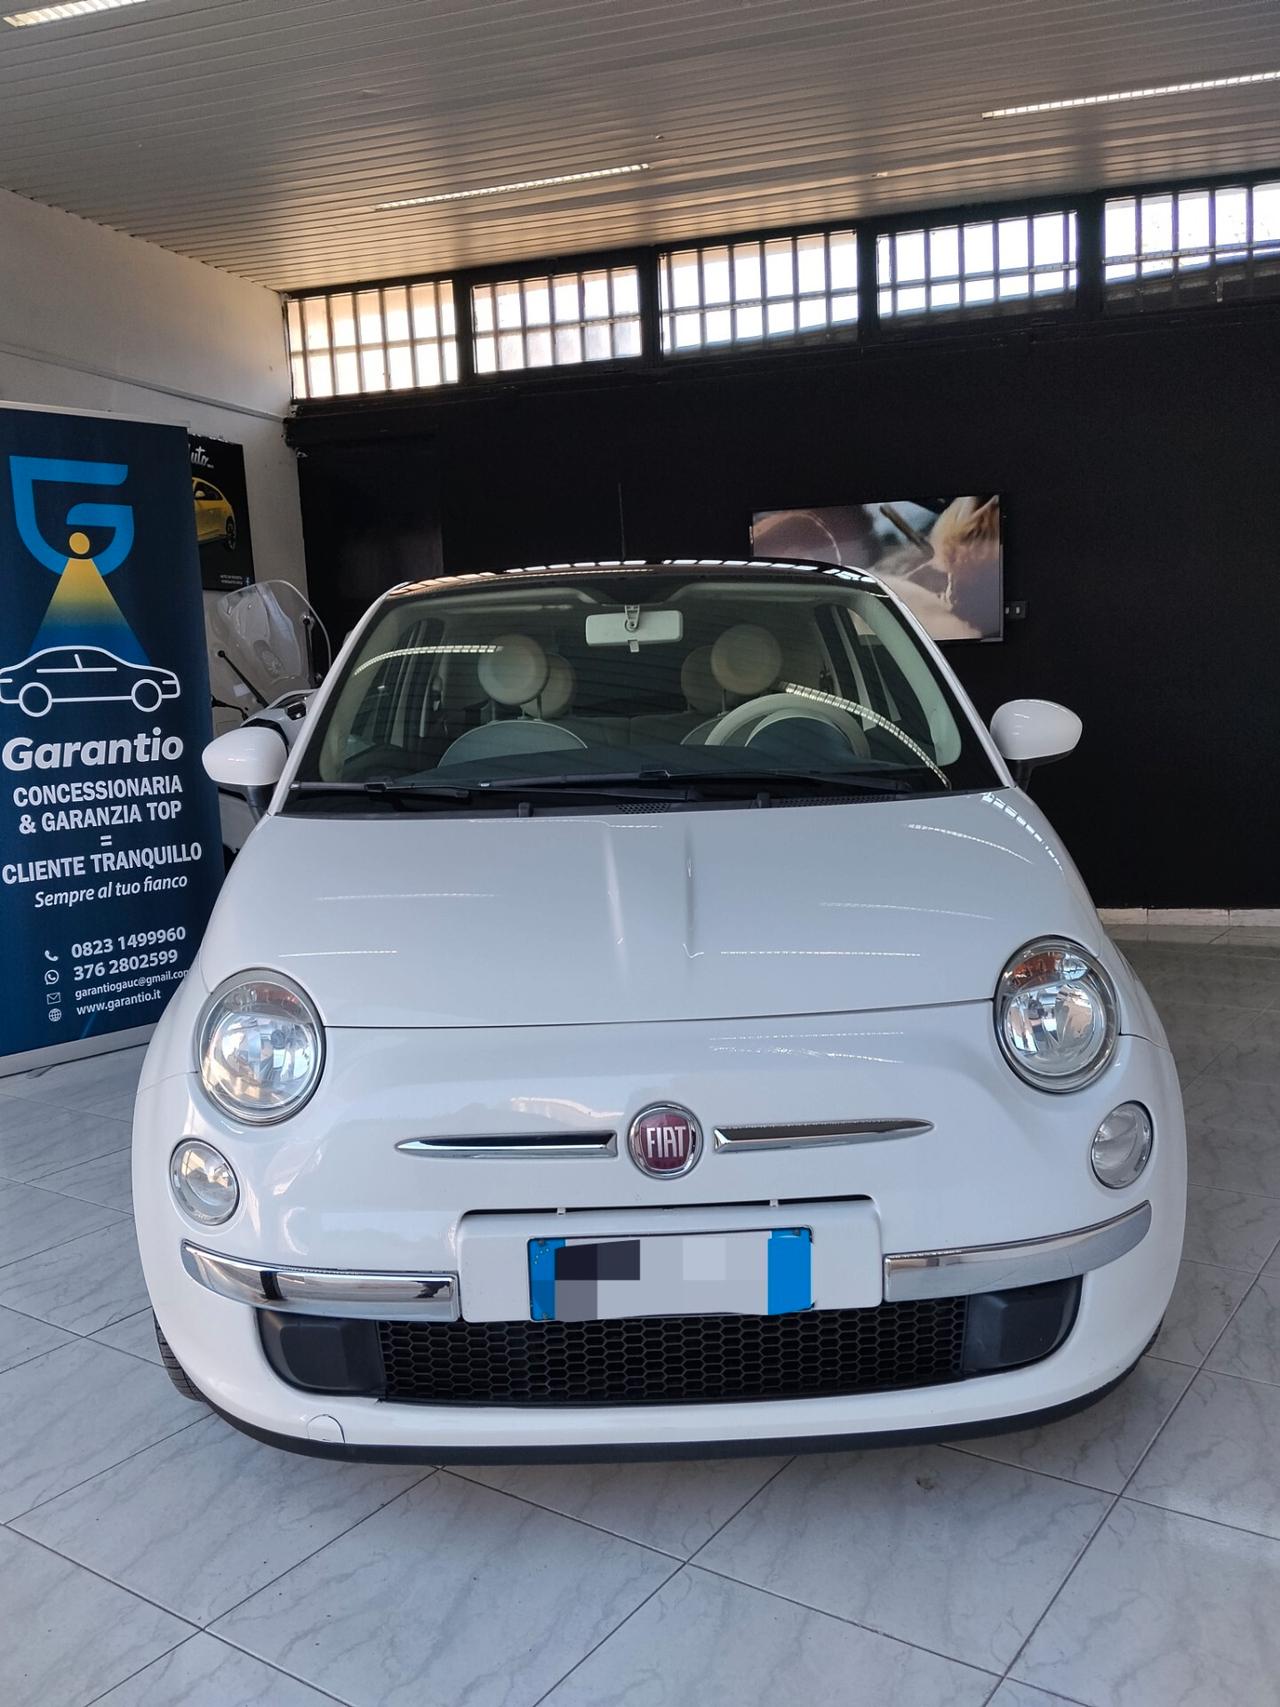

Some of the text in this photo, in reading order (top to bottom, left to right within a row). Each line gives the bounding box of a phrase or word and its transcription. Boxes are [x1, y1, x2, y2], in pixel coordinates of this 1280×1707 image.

[1, 726, 184, 772] Garantio
[13, 774, 183, 807] CONCESSIONARIA
[18, 800, 182, 835] & GARANZIA TOP
[2, 842, 202, 885] CLIENTE TRANQUILLO
[34, 875, 188, 908] Sempre al tuo fianco
[71, 926, 186, 959] 0823 1499960
[73, 949, 178, 981] 376 2802599
[76, 989, 161, 1016] www.garantio.it
[646, 1126, 686, 1158] FIAT
